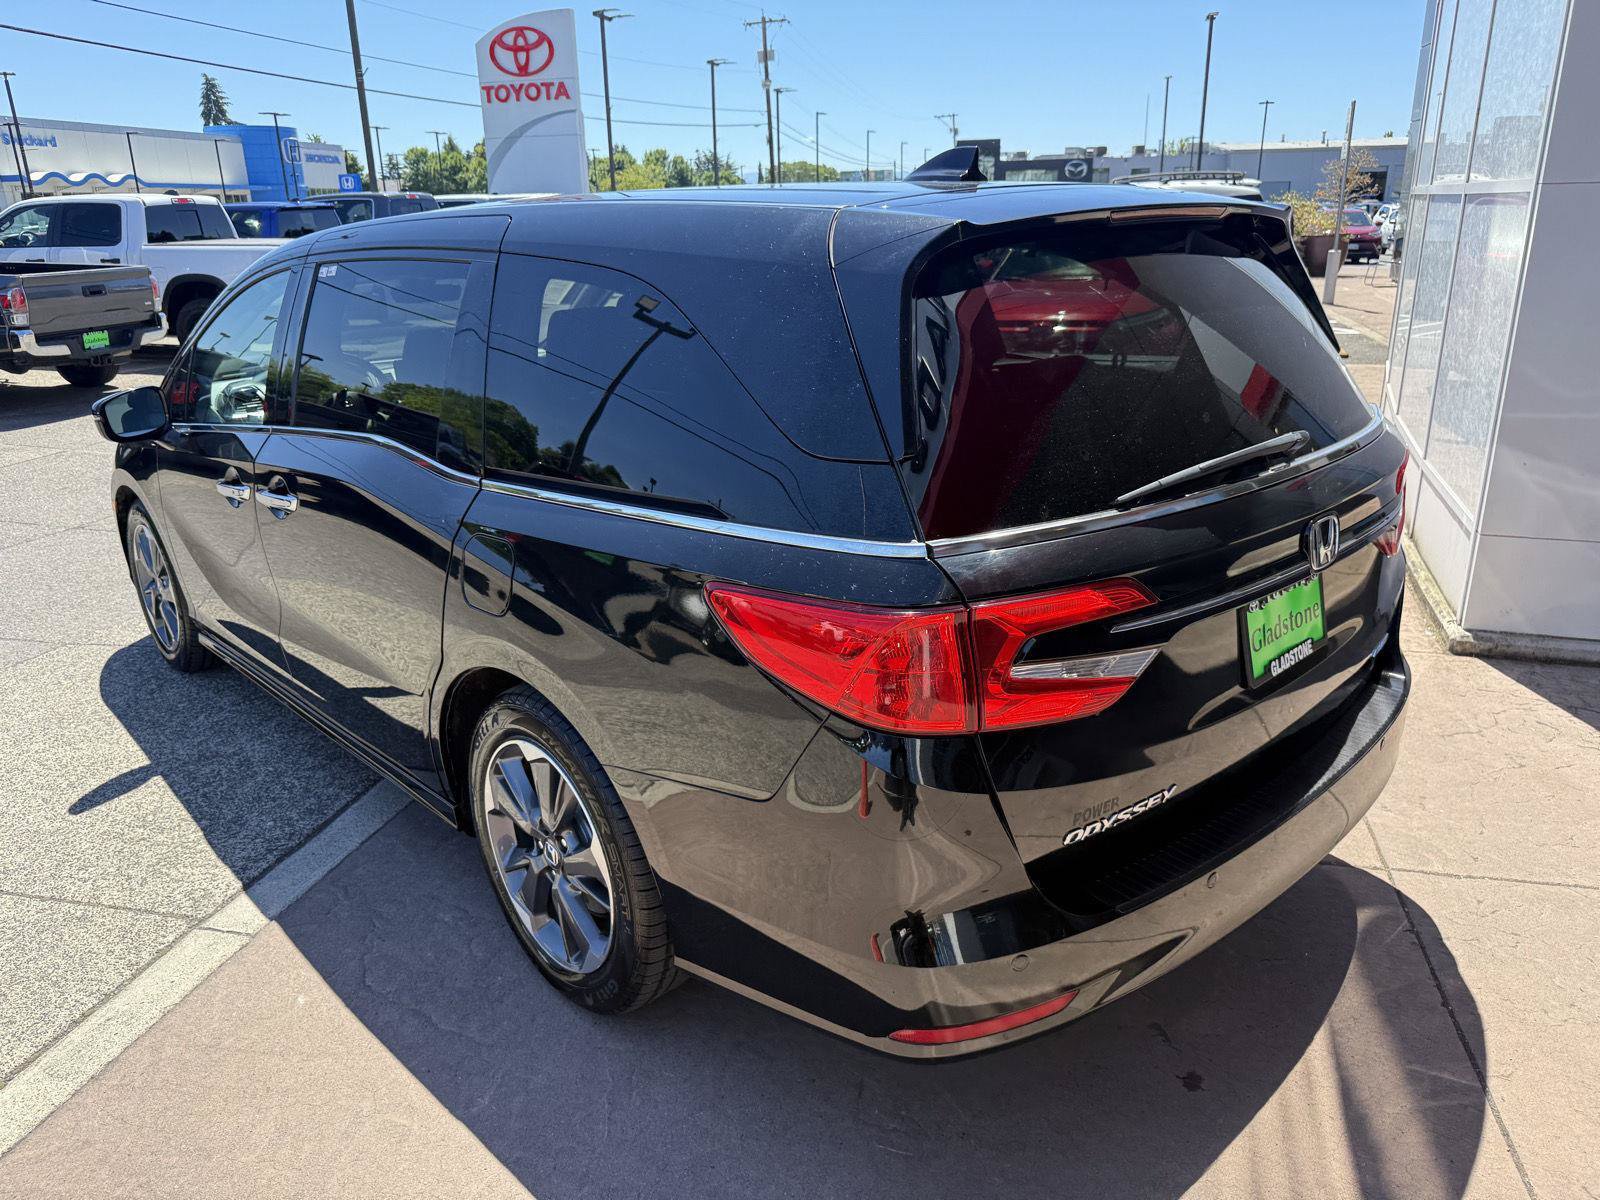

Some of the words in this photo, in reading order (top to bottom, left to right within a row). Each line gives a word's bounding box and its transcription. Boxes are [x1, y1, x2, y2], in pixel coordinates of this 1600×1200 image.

[481, 81, 571, 104] TOYOTA
[1251, 602, 1320, 652] Gladstone
[1270, 639, 1313, 676] GLADSTONE
[1062, 783, 1178, 846] ODYSSEY
[1072, 797, 1120, 827] POWER
